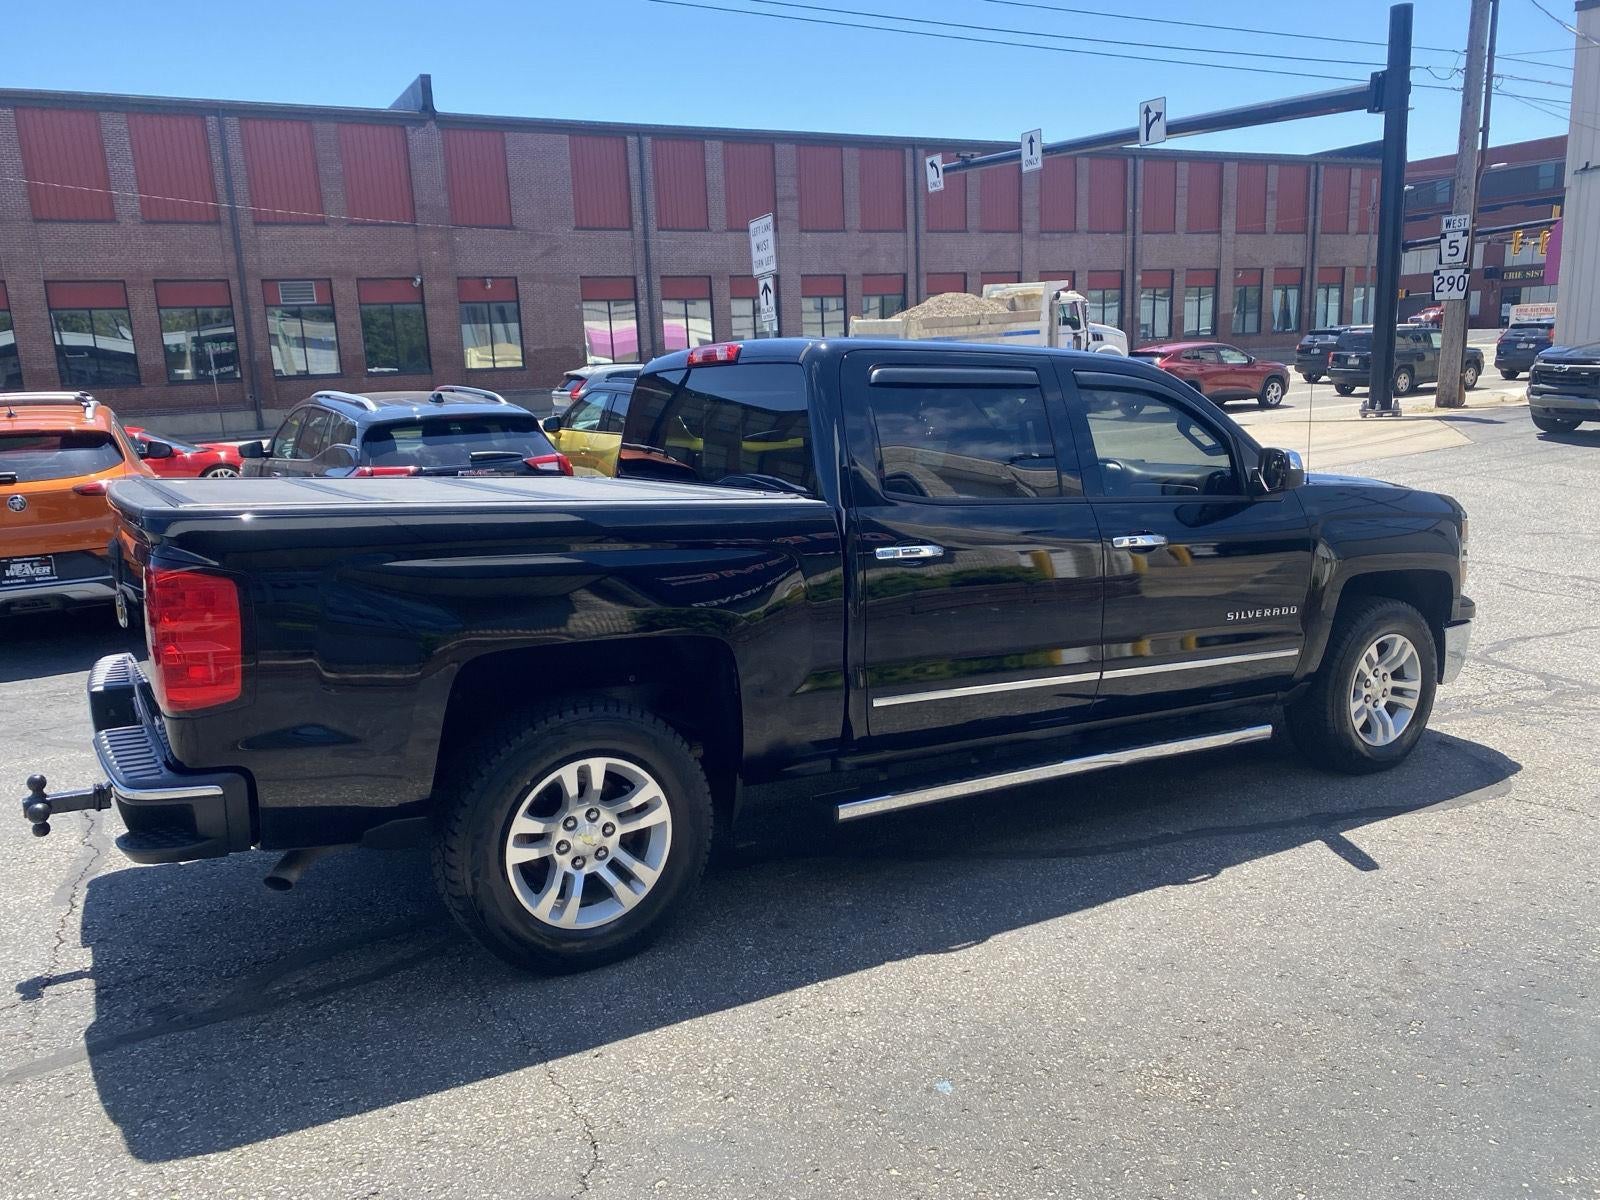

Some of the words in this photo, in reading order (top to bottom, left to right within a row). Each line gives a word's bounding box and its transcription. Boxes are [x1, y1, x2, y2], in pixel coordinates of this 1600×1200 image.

[1025, 157, 1039, 168] ONLY
[930, 180, 941, 189] ONLY
[751, 225, 761, 237] LEFT
[761, 221, 772, 234] LANE
[1445, 217, 1467, 230] WEST
[756, 239, 769, 253] MUST
[1447, 239, 1460, 257] 5
[754, 258, 764, 269] TURN
[764, 255, 774, 267] LEFT
[1435, 274, 1467, 293] 290
[5, 566, 51, 577] WEAVER
[1226, 605, 1298, 621] SILVERADO
